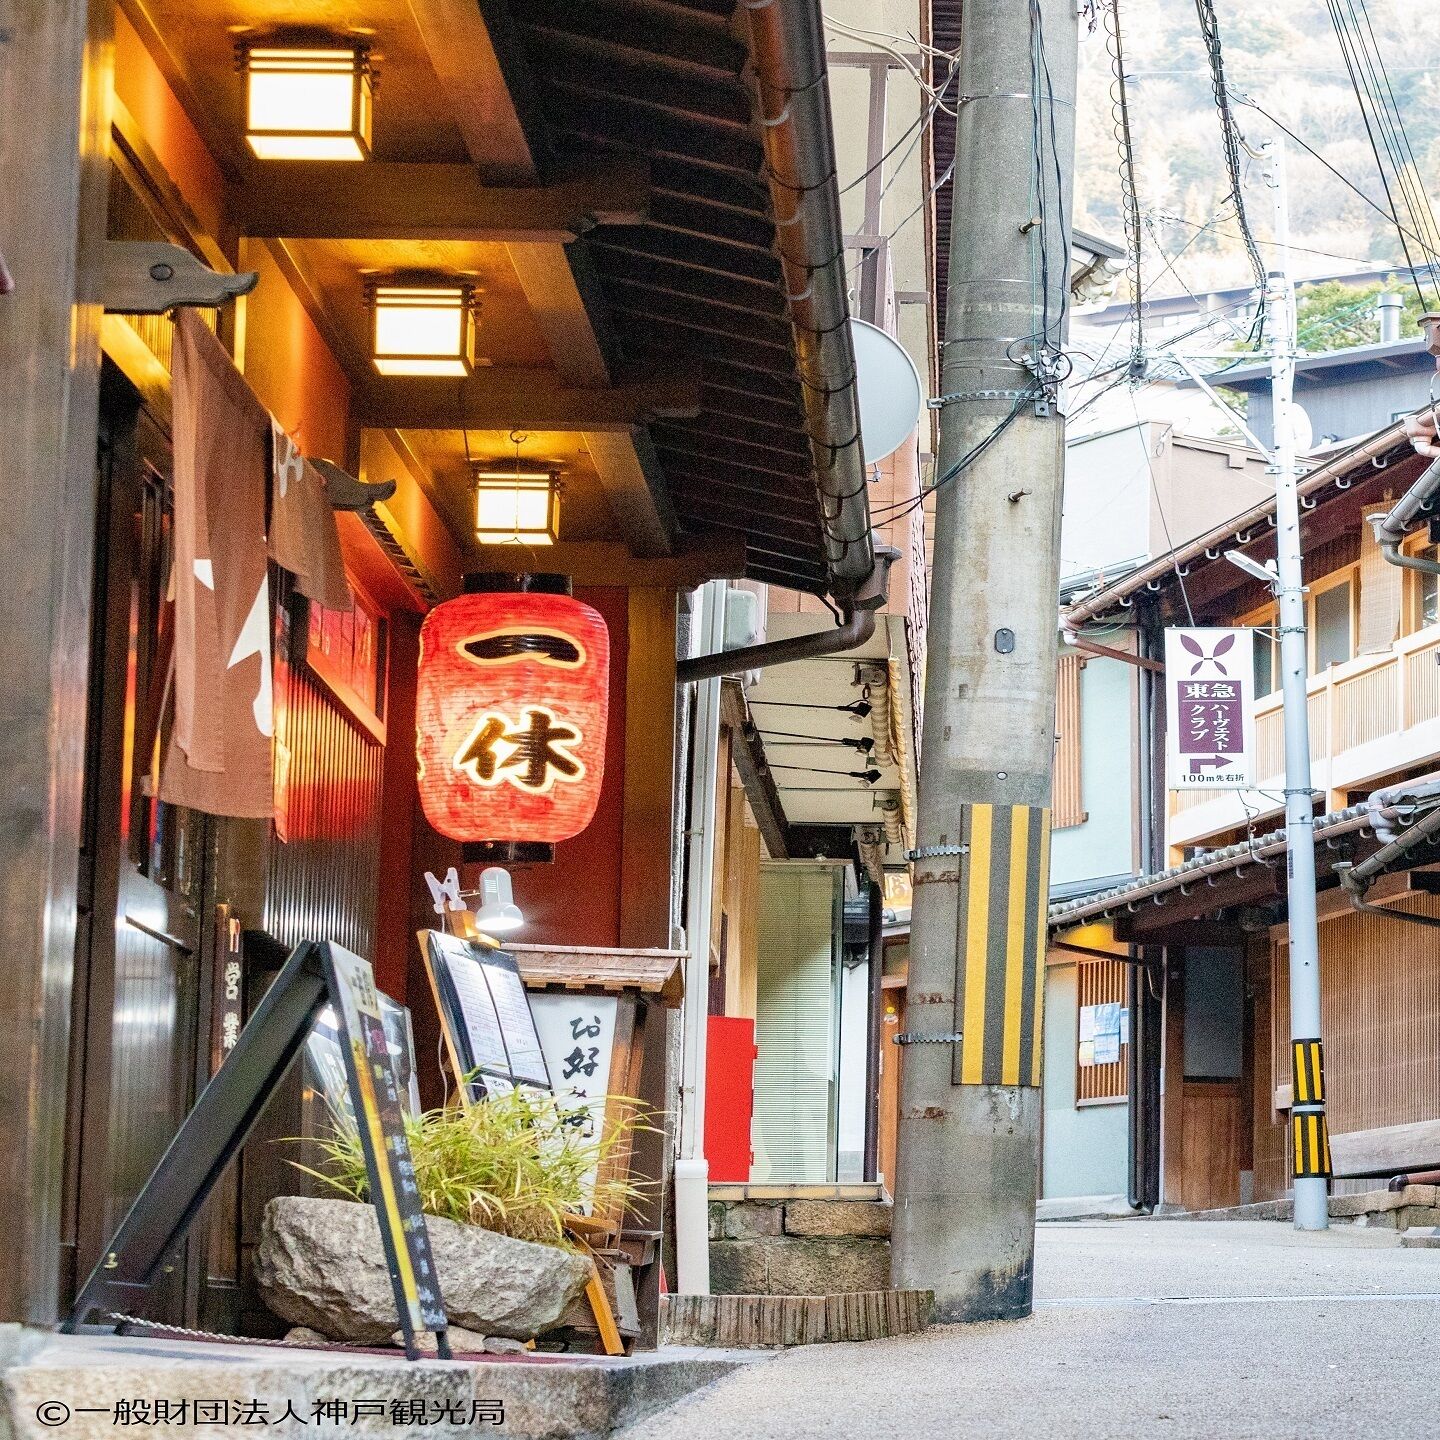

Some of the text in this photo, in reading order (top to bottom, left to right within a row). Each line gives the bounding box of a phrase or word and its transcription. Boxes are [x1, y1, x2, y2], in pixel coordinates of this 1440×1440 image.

[1184, 683, 1236, 698] 東急
[454, 628, 587, 793] 一休
[1190, 704, 1210, 741] クラブ
[1211, 704, 1230, 751] ハーヴェスト
[1183, 774, 1244, 782] 100m先右折
